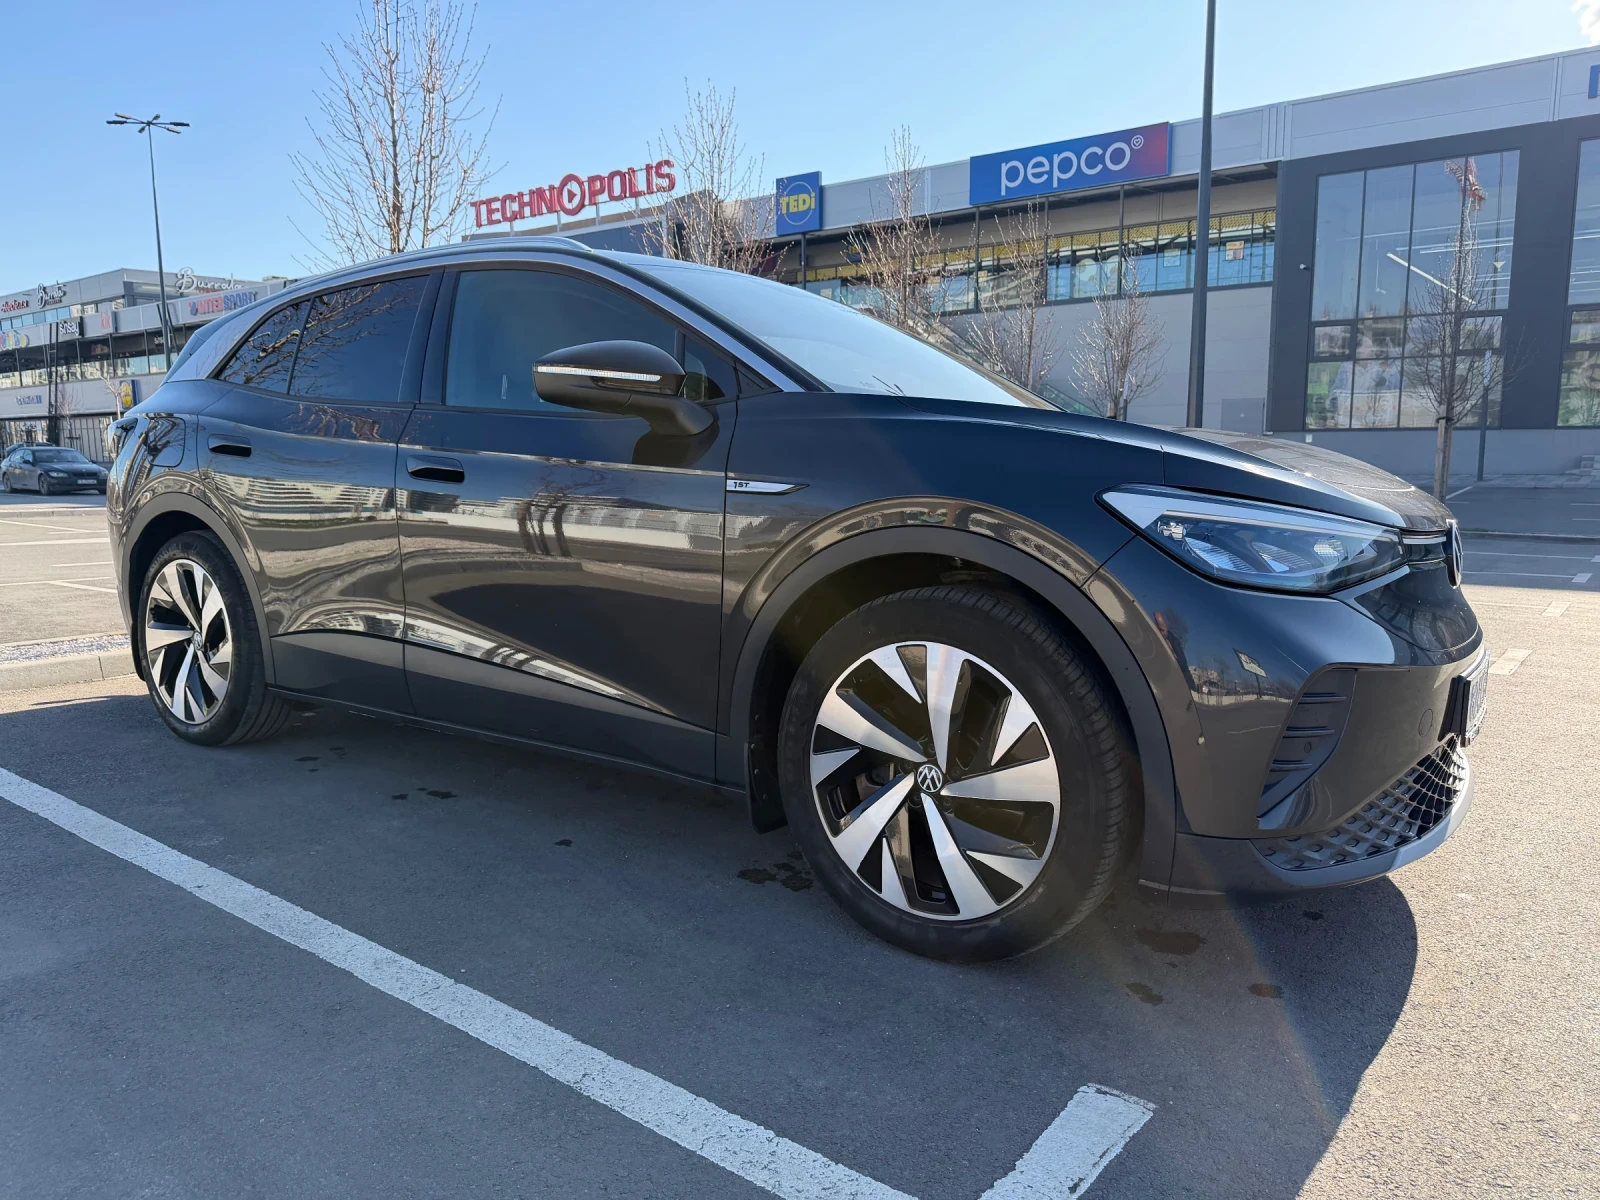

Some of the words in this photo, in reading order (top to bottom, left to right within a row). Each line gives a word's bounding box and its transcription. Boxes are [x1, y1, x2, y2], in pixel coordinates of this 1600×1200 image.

[1001, 141, 1131, 196] pepco
[470, 159, 676, 228] TECHNOPOLIS
[780, 191, 816, 214] TEDi
[733, 481, 750, 489] 1ST
